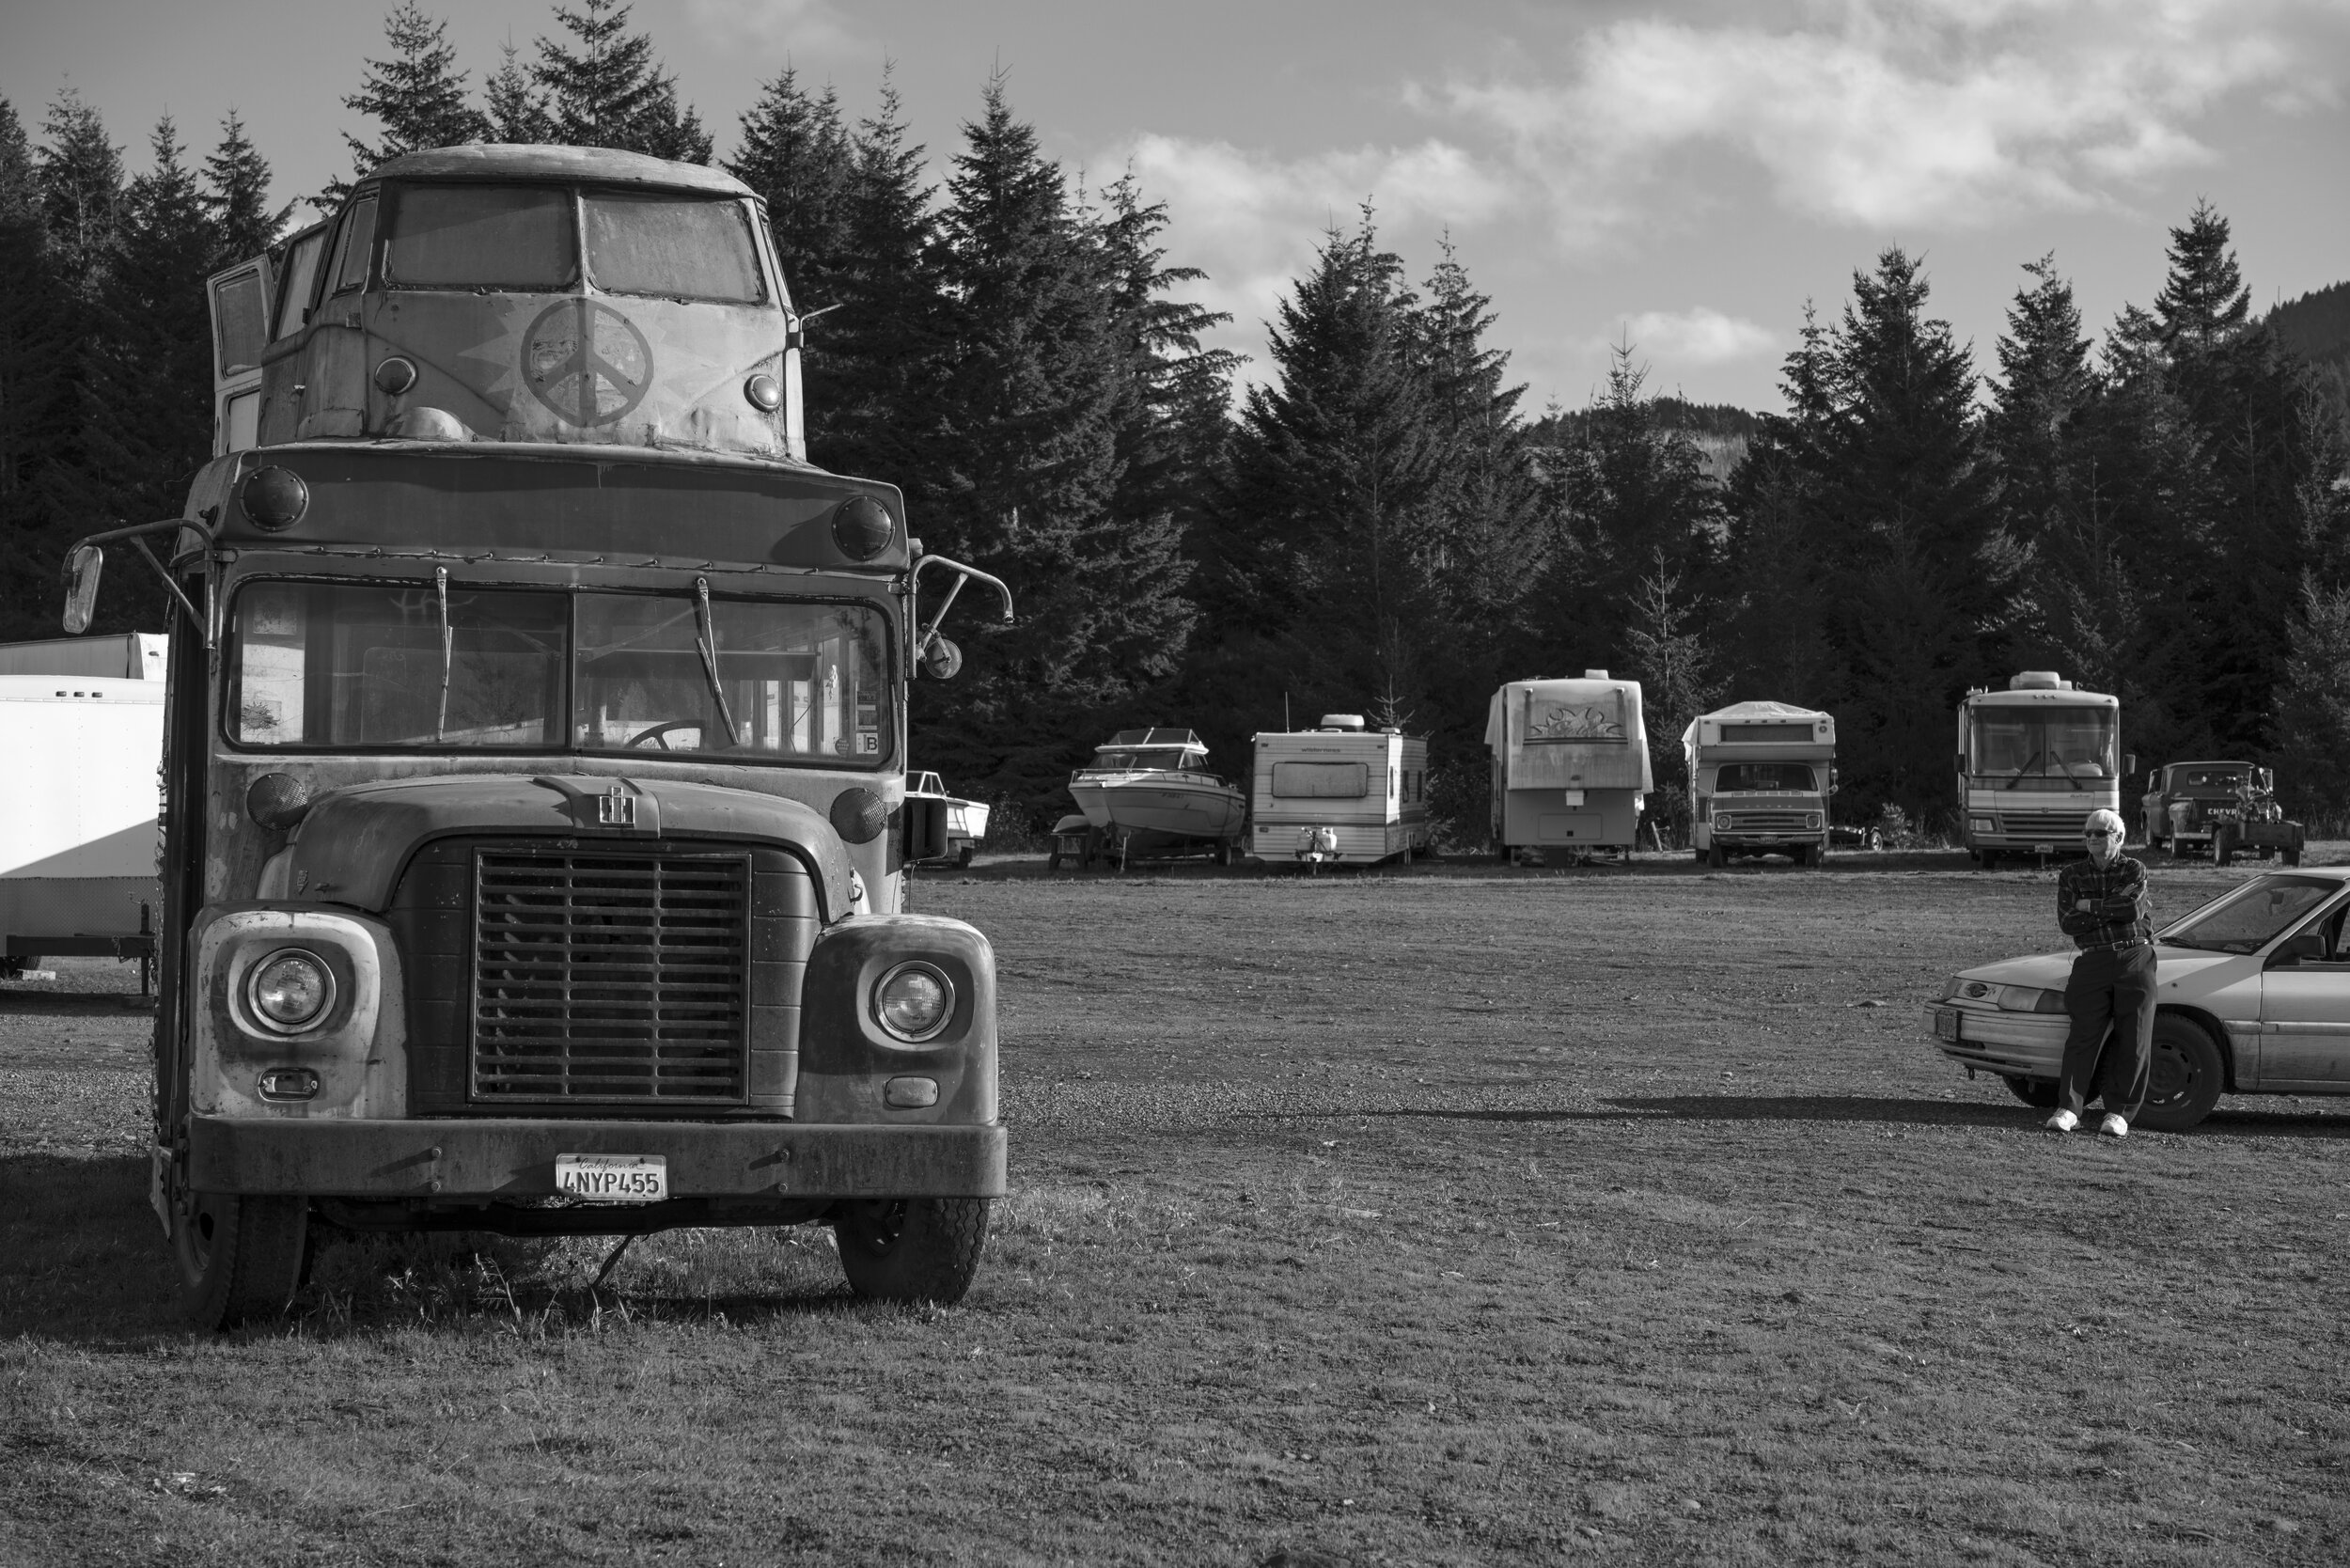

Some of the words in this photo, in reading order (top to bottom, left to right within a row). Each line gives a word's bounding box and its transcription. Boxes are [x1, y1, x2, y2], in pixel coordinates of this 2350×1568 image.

[867, 737, 878, 750] B
[2207, 808, 2241, 816] CHEVR
[579, 1157, 647, 1172] California
[564, 1171, 660, 1194] 4NYP455
